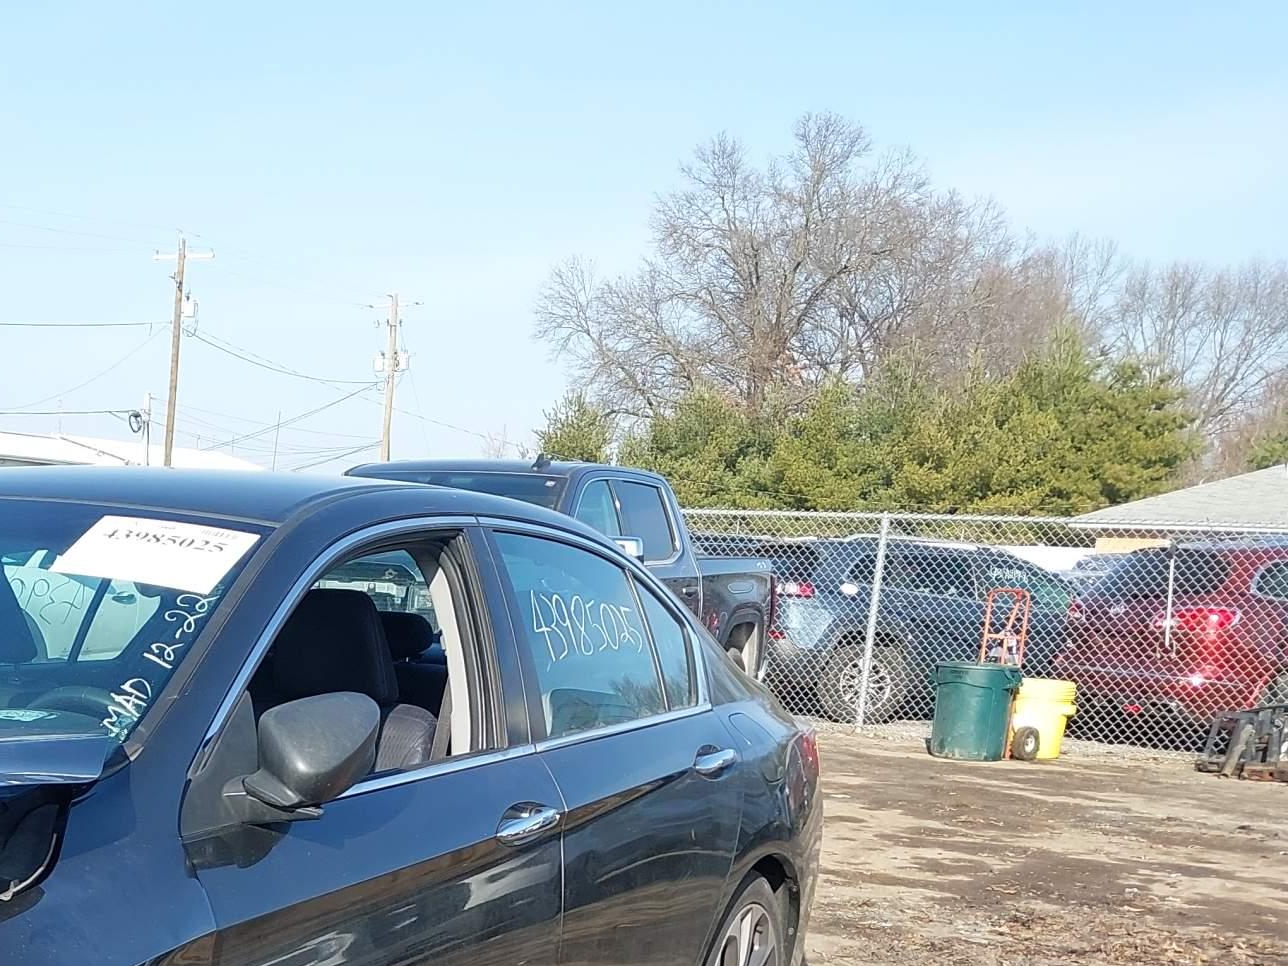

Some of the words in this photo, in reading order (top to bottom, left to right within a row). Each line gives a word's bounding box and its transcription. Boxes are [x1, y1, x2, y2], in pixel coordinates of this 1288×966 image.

[103, 527, 229, 553] 43985025
[530, 588, 644, 663] 43985025
[100, 678, 153, 736] MAD
[142, 593, 221, 670] 12-22
